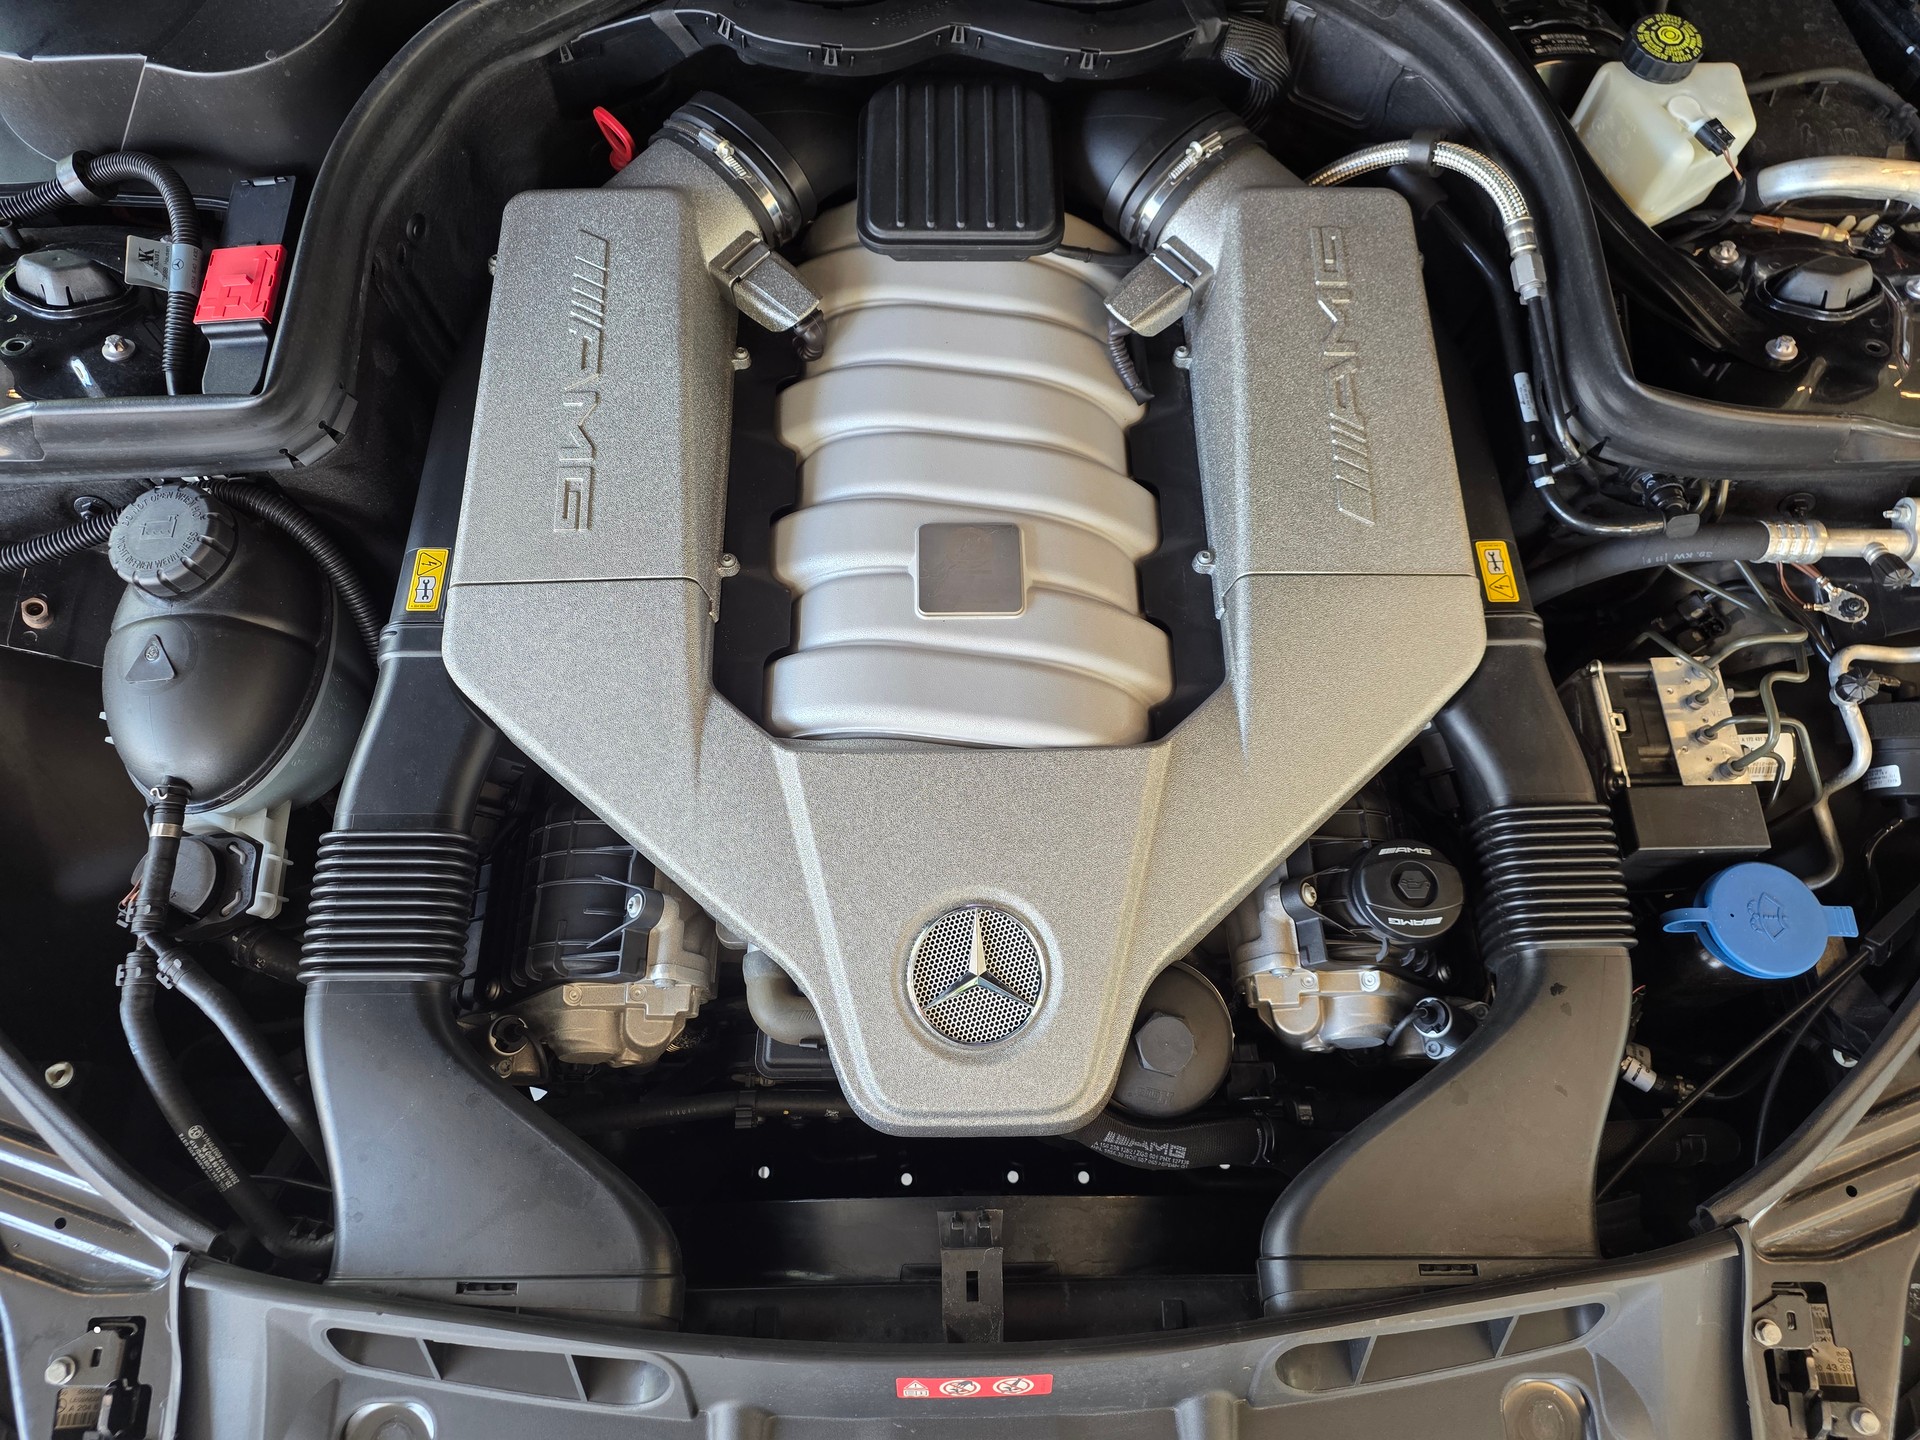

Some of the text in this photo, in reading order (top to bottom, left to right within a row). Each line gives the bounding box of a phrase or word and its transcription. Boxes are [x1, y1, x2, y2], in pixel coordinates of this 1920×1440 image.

[150, 491, 174, 503] OPEN
[175, 491, 198, 509] WHEN
[155, 552, 180, 568] WENN
